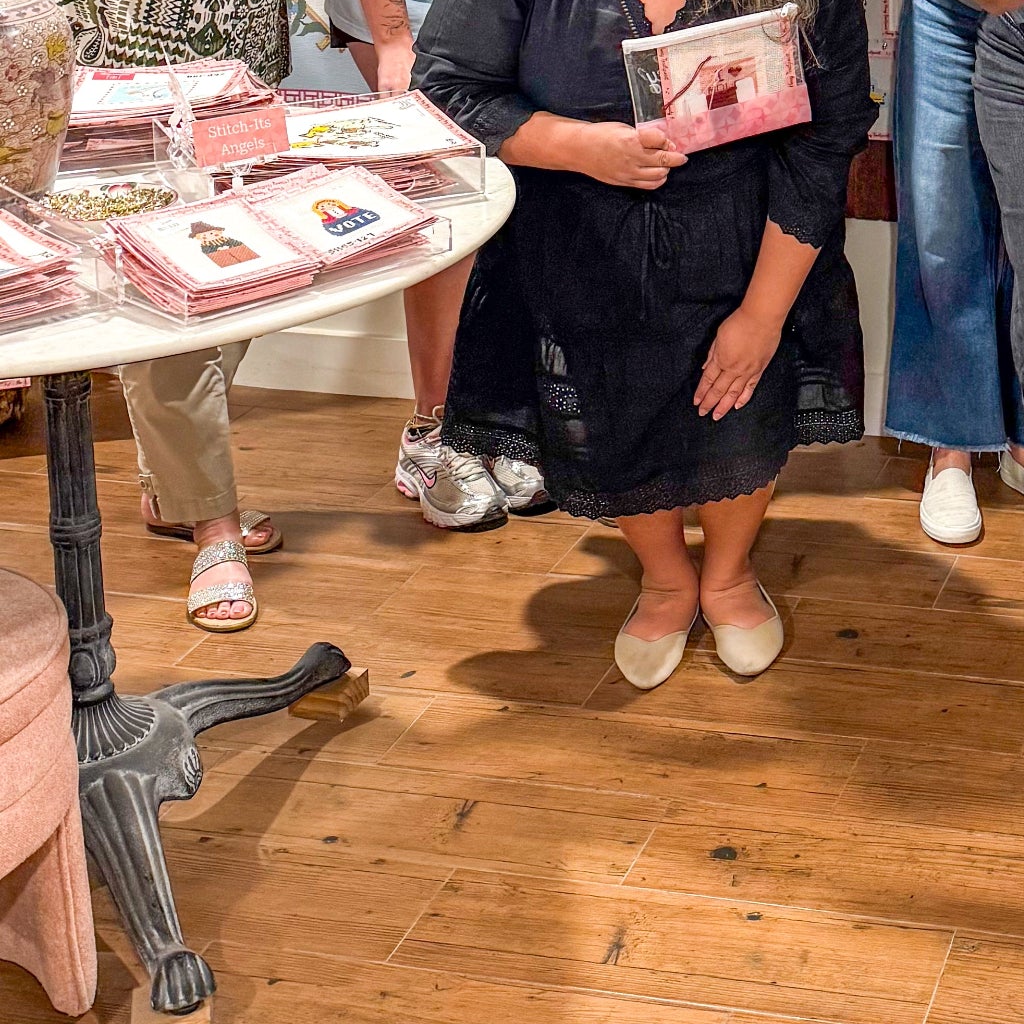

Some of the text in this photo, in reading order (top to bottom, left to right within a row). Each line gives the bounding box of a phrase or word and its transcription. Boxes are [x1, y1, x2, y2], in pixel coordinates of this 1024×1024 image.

[208, 117, 272, 138] Stitch-Its
[221, 137, 266, 157] Angels
[329, 211, 379, 235] VOTE
